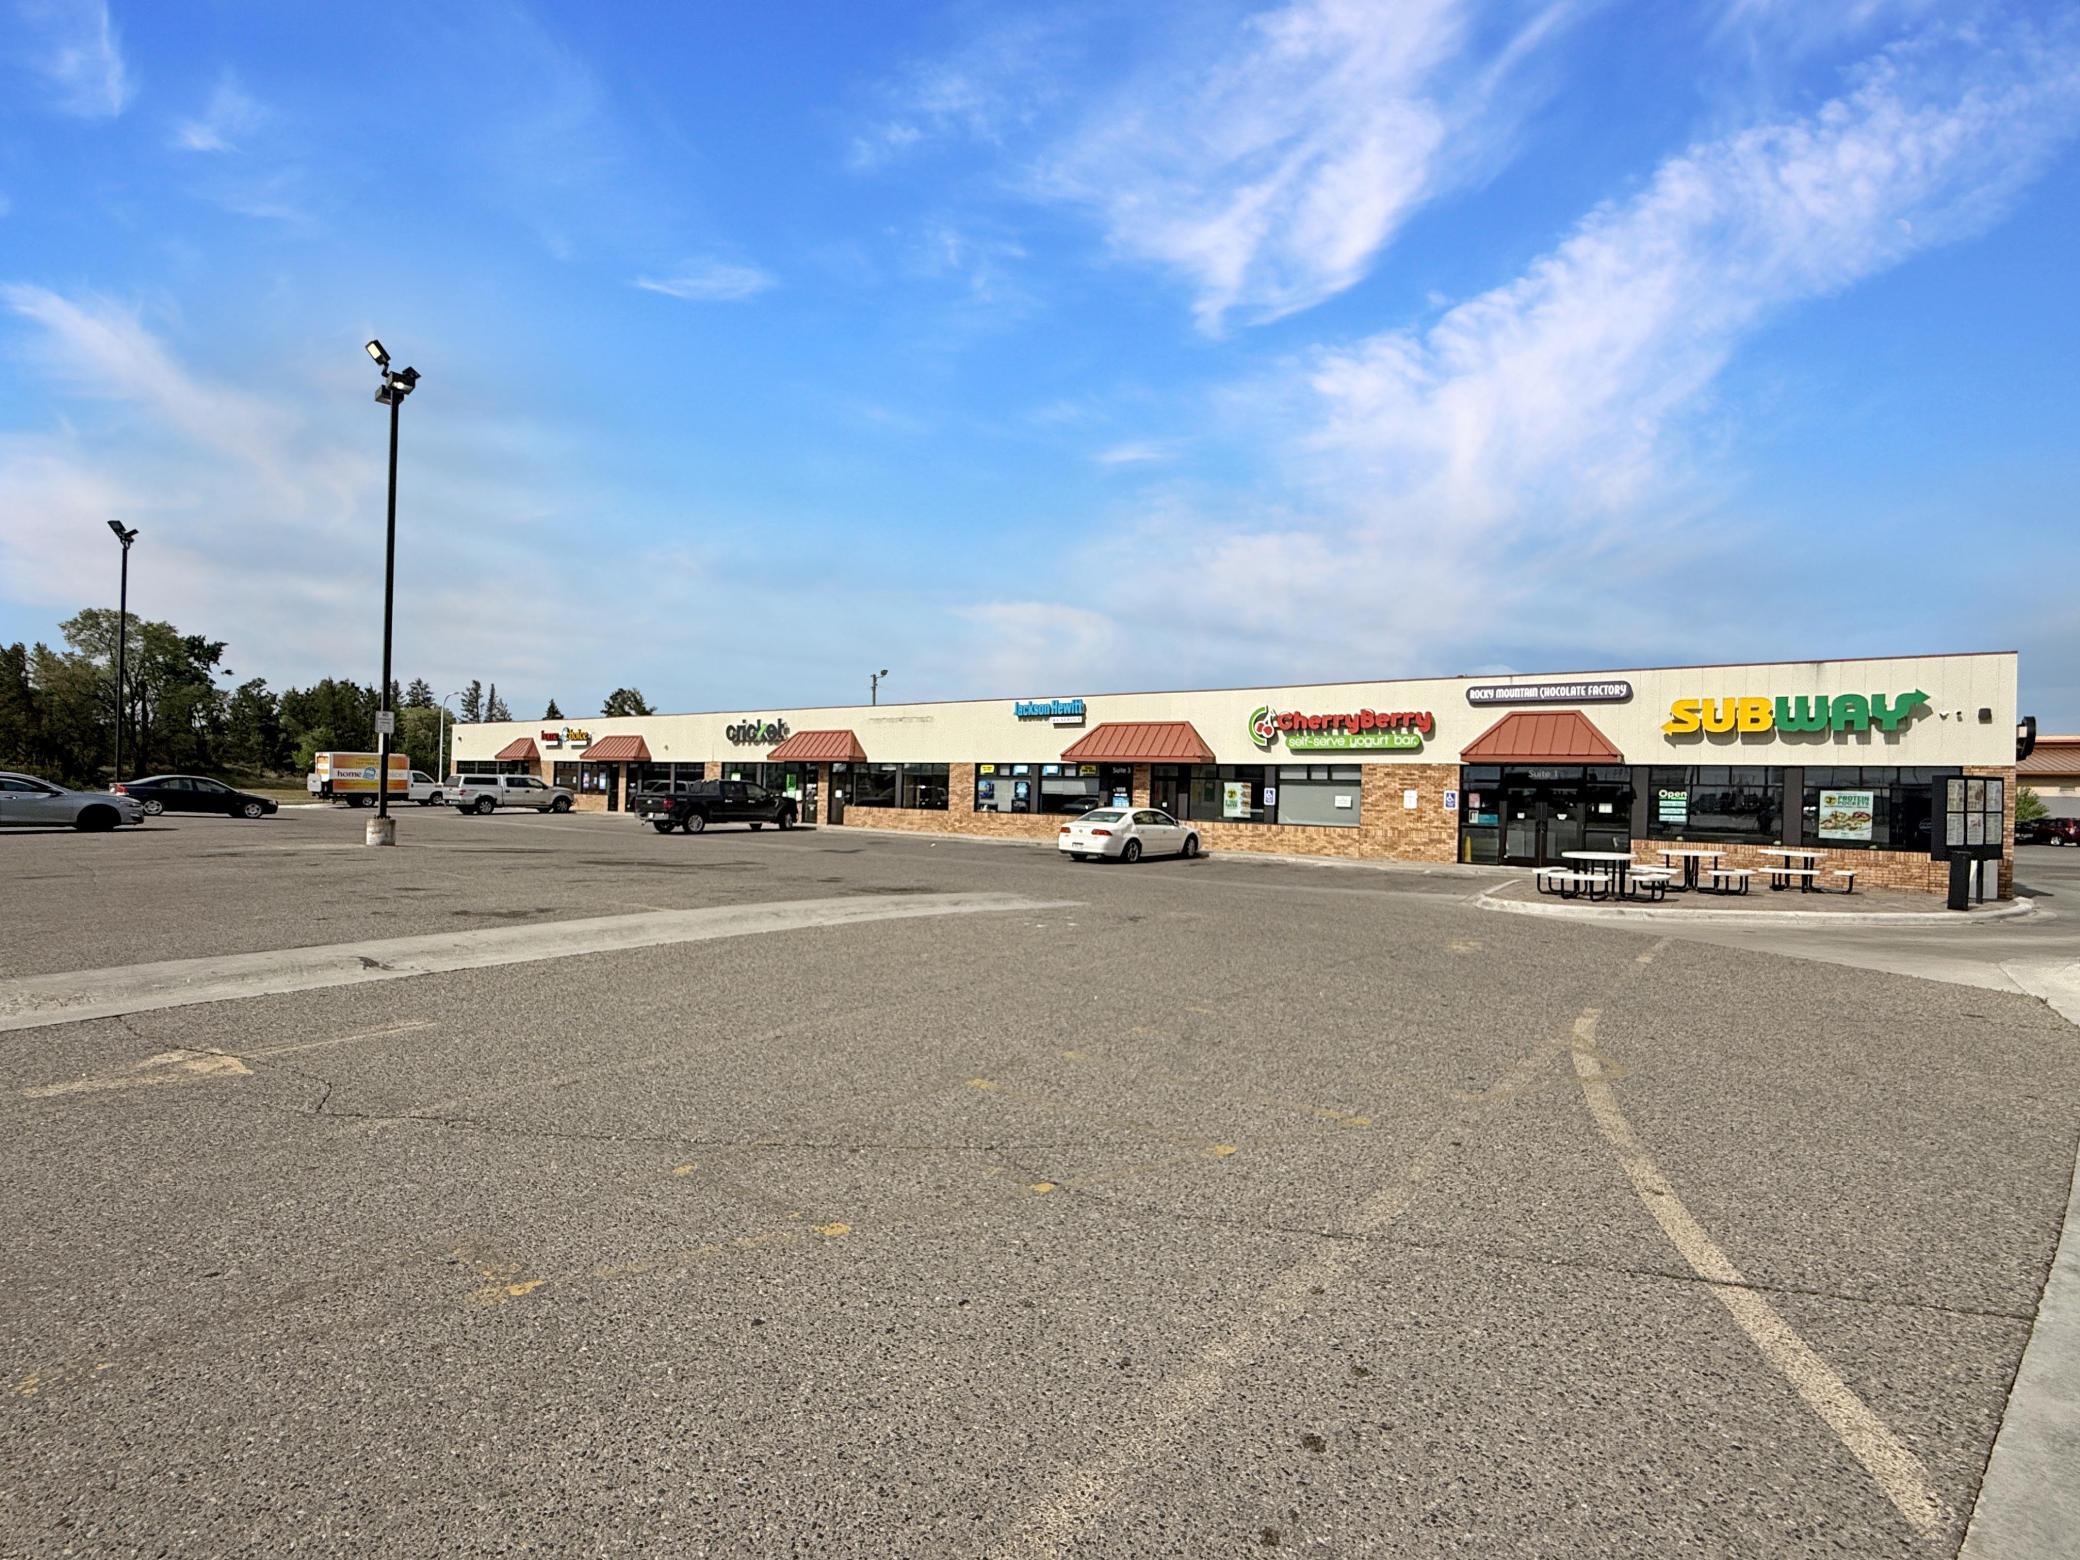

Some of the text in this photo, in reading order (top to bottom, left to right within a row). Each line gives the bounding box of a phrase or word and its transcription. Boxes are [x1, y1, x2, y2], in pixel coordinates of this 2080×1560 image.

[1470, 684, 1627, 699] ROCKY MOUNTAIN CHOCOLATE FACTORY
[1014, 699, 1085, 716] Jackson Hewitt
[1661, 689, 1931, 733] SUBWAY
[1277, 708, 1433, 734] CherryBerry
[726, 718, 785, 741] cricket
[1288, 735, 1345, 747] self-serve
[1350, 735, 1389, 748] yogurt
[337, 769, 361, 778] home
[1528, 770, 1550, 778] Suite
[1658, 789, 1688, 800] Open
